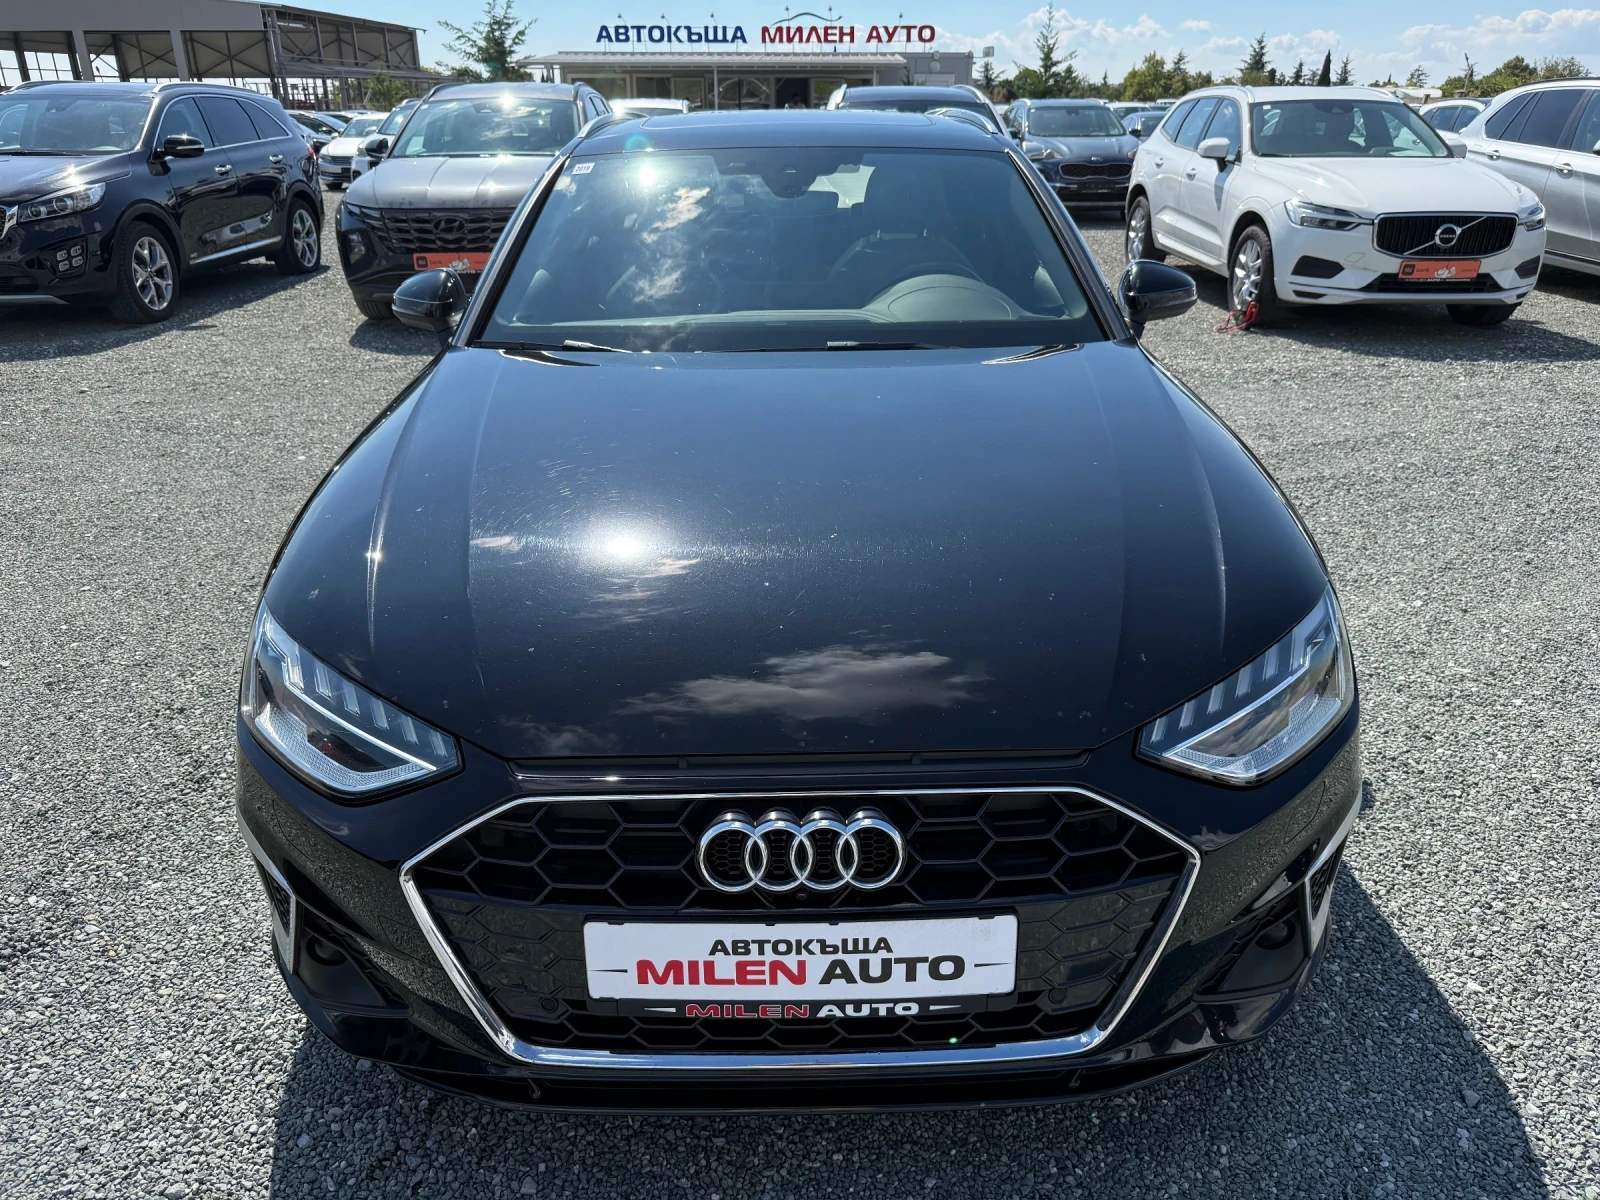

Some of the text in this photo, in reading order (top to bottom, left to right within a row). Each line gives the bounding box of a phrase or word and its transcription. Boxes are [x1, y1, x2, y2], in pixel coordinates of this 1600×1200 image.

[596, 25, 936, 44] АВТОКЪЩА МИЛЕН АУТО
[708, 936, 893, 956] АВТОКЪЩА
[636, 954, 965, 986] MILEN AUTO
[685, 1002, 919, 1019] MILEN AUTO
